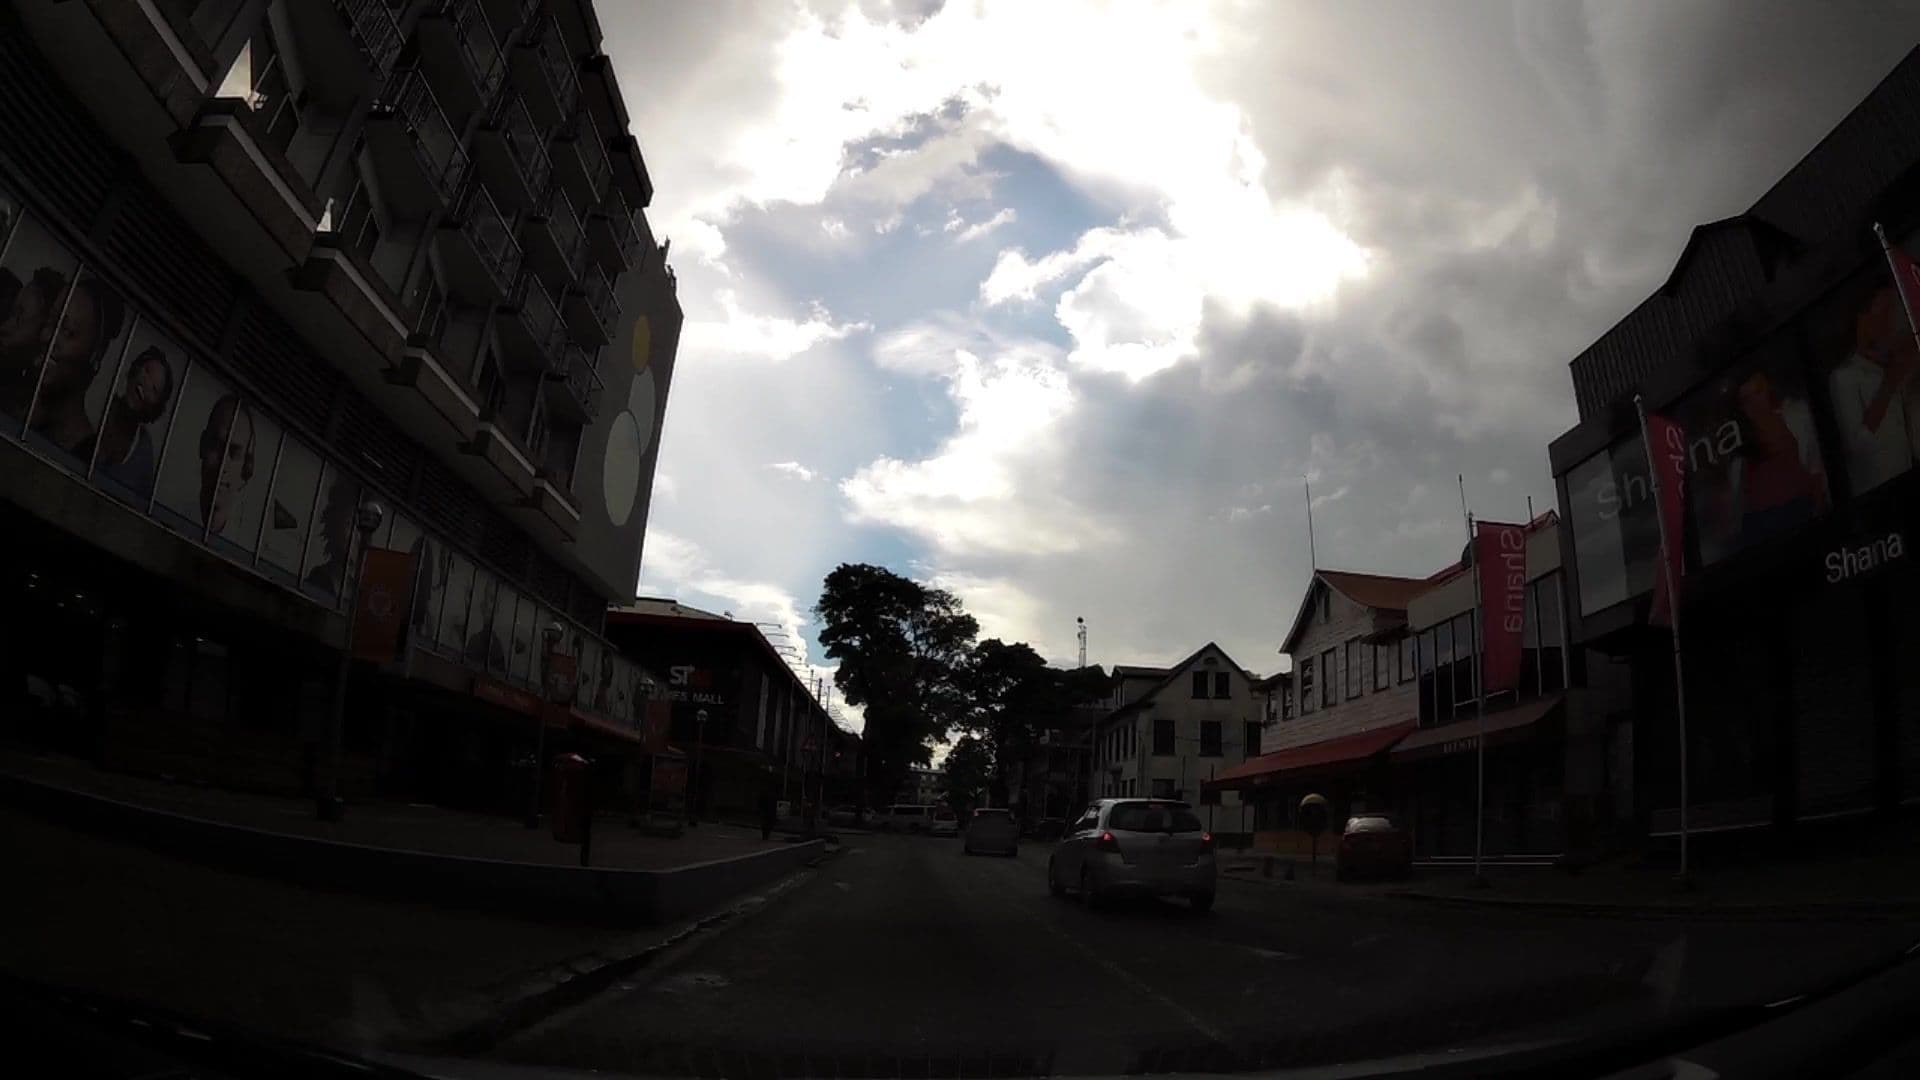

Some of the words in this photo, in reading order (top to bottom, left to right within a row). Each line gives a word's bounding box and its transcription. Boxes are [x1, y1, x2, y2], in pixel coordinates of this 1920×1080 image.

[1597, 418, 1744, 521] Shna
[1824, 532, 1905, 584] Shana
[692, 691, 725, 705] MALL
